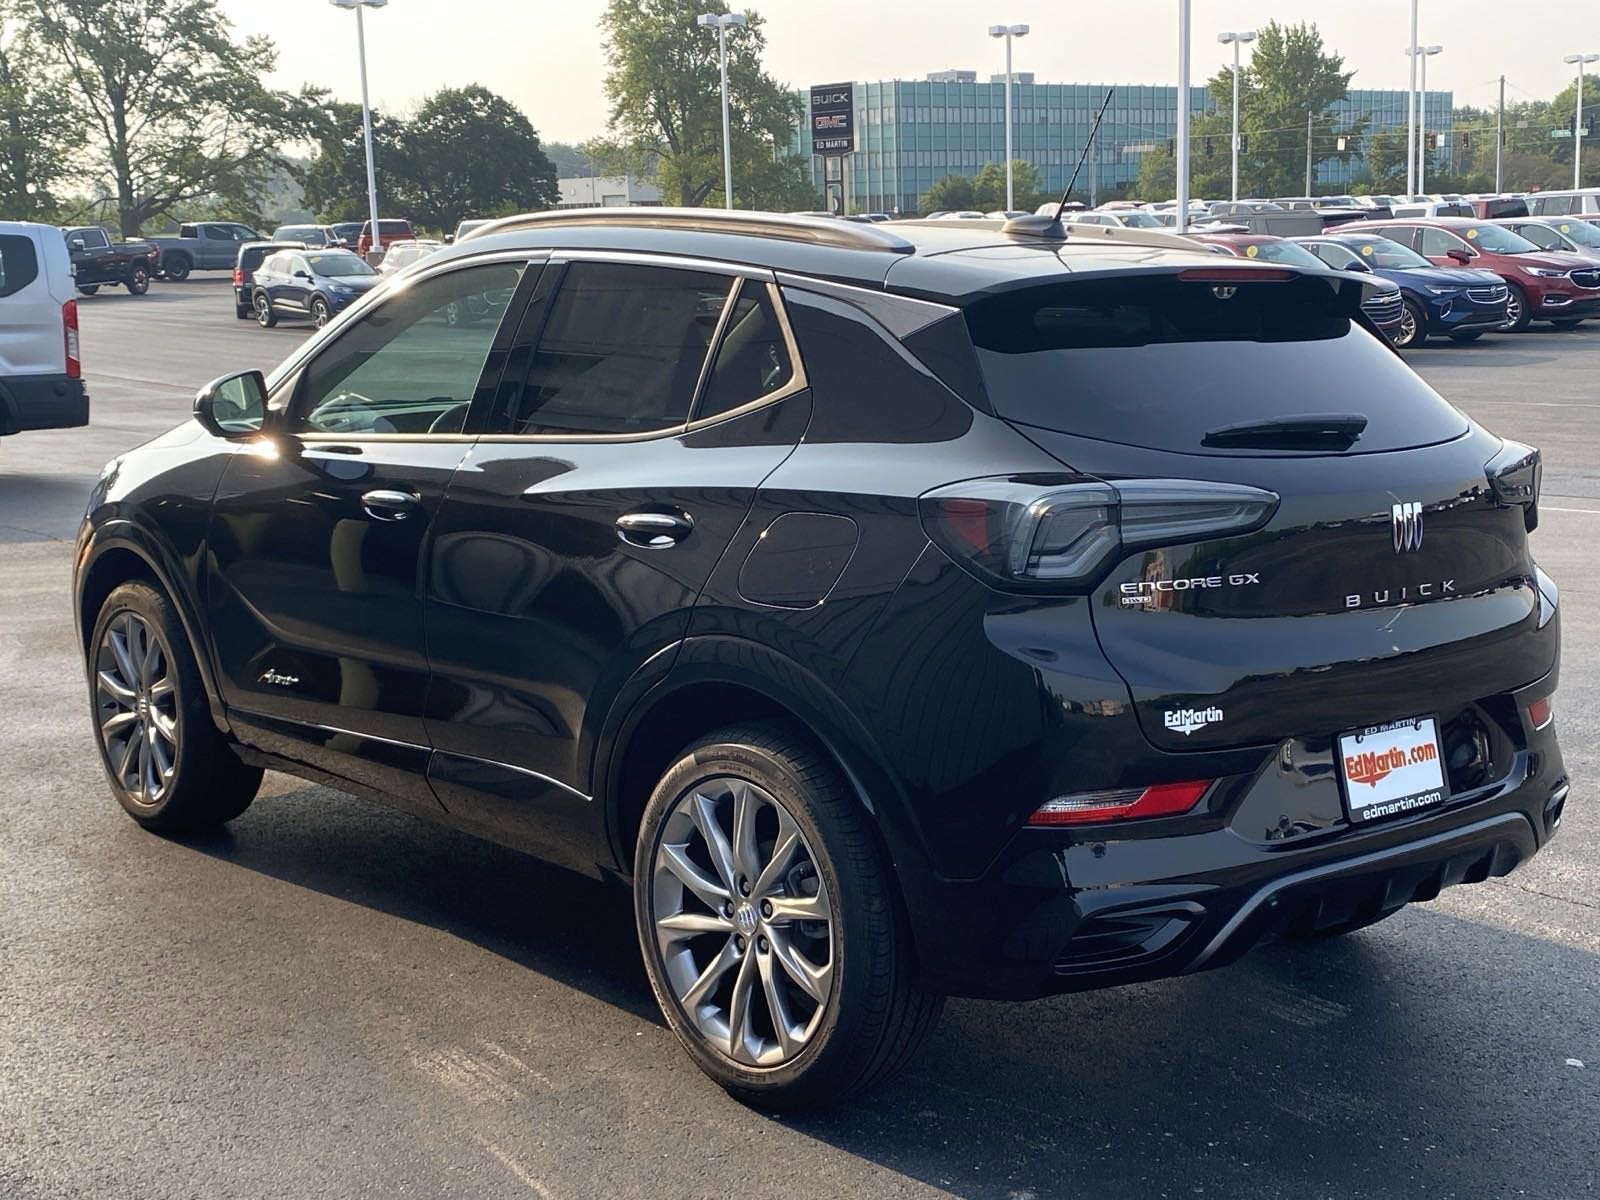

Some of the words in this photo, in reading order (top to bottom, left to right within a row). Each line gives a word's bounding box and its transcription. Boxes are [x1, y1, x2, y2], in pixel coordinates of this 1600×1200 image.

[812, 93, 848, 104] BUICK
[815, 115, 847, 128] GMC
[816, 141, 825, 149] ED
[826, 140, 848, 149] MARTIN
[1120, 576, 1222, 594] ENCORE
[1228, 572, 1260, 586] GX
[1345, 579, 1456, 608] BUICK
[1164, 706, 1223, 730] EdMartin
[1364, 726, 1378, 736] ED
[1380, 718, 1417, 733] MARTIN
[1363, 792, 1441, 820] edmartin.com
